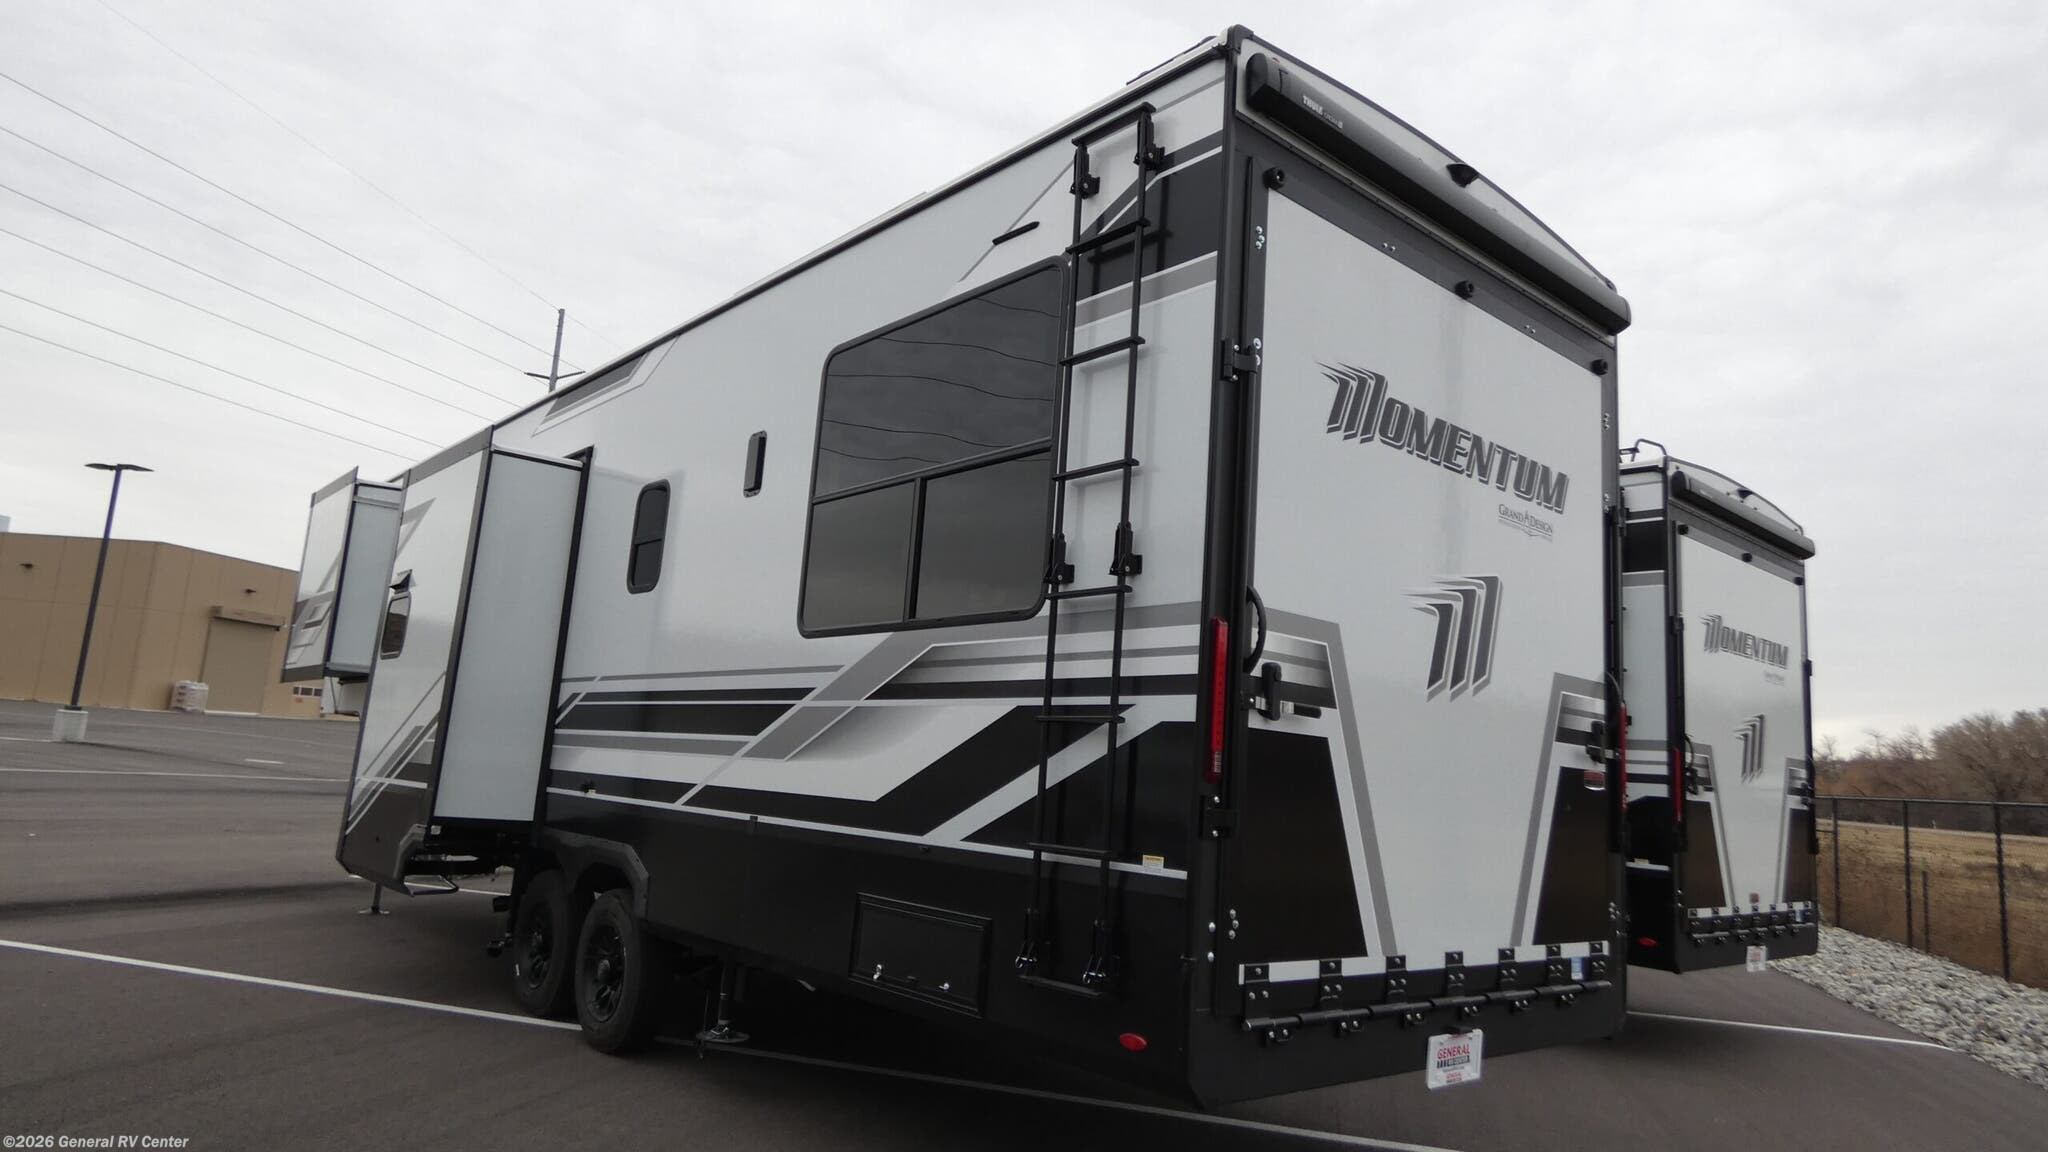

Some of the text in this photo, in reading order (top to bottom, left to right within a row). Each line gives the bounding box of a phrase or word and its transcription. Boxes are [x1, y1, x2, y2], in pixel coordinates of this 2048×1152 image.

[1313, 360, 1570, 515] MOMENTUM
[1700, 613, 1788, 670] MOMENTUM
[1437, 1043, 1470, 1060] GENERAL
